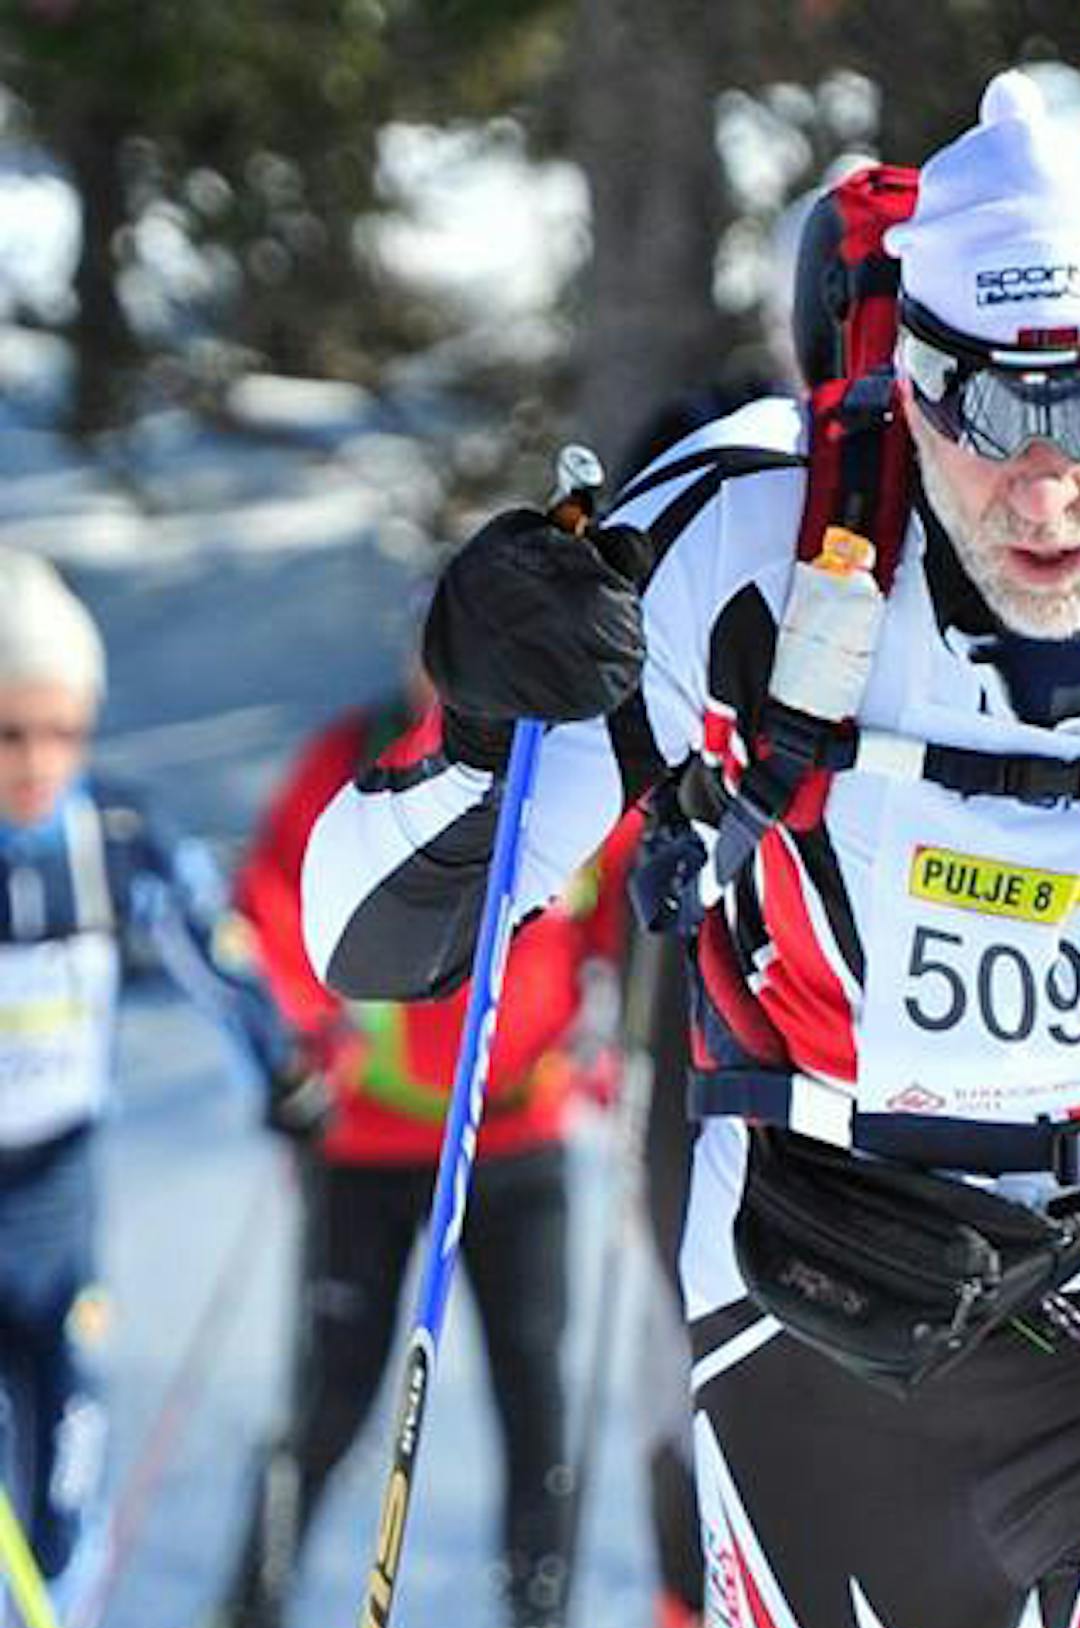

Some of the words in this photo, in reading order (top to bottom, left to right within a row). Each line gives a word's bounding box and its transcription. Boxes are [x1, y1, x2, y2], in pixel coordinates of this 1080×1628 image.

[976, 264, 1078, 289] sport
[923, 857, 1025, 906] PULJE
[1033, 881, 1055, 911] 8
